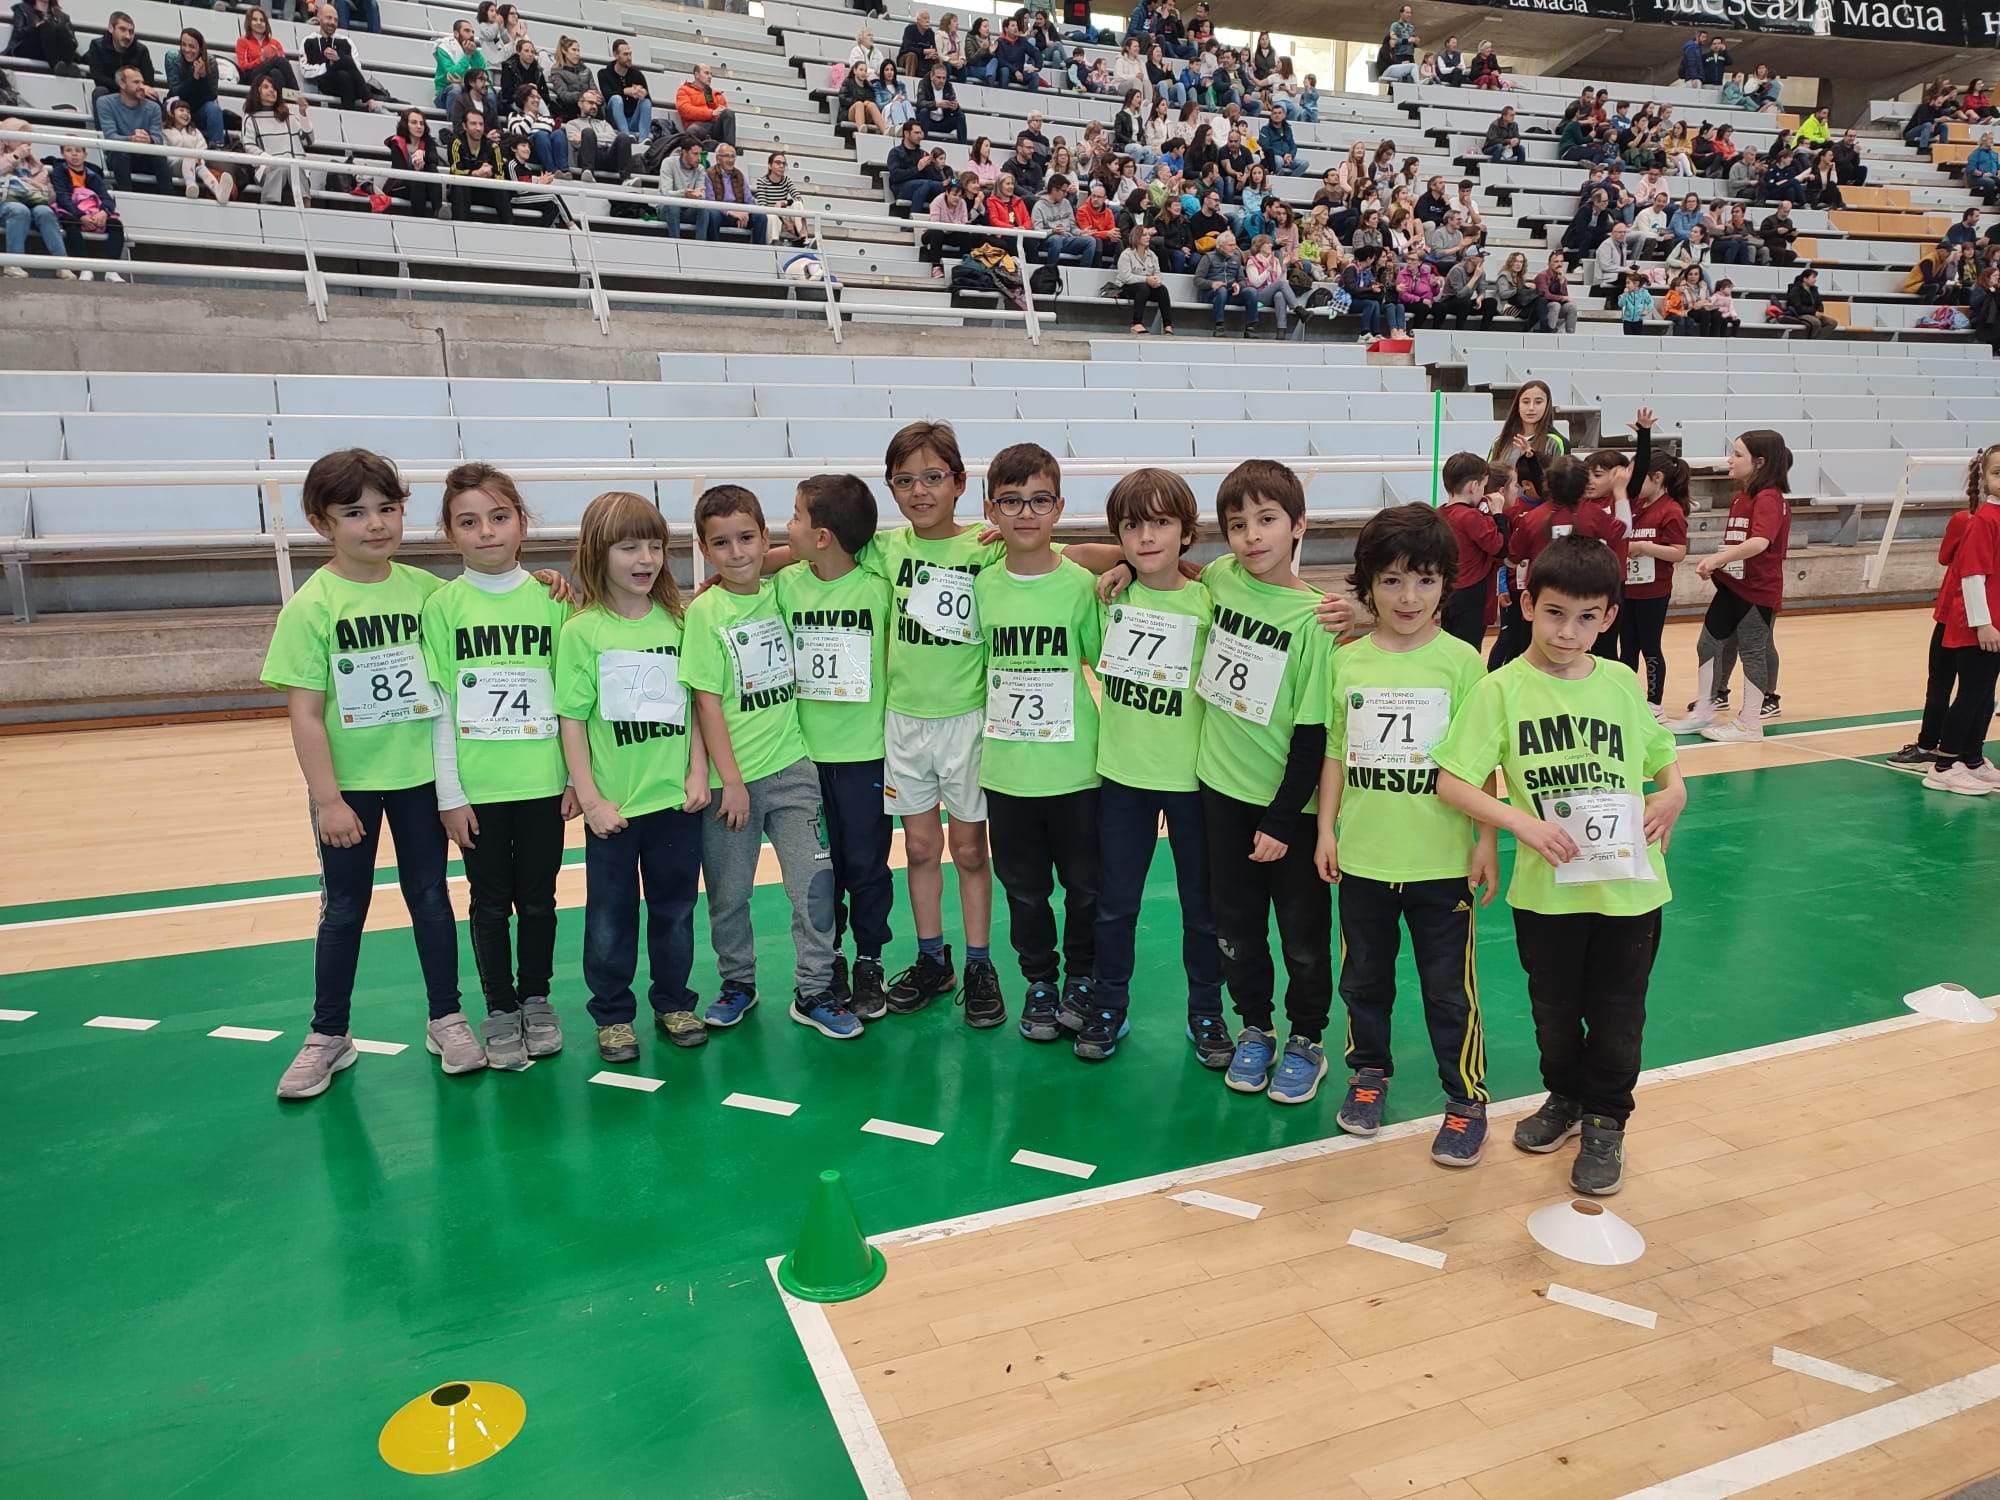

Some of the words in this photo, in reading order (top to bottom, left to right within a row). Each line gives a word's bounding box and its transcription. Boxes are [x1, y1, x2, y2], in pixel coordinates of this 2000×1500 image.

[936, 590, 971, 620] 80
[456, 625, 552, 661] AMYPA
[760, 636, 787, 667] 75
[992, 625, 1068, 657] AMYPA
[1128, 629, 1167, 661] 77
[811, 653, 838, 679] 81
[1214, 653, 1249, 691] 78
[371, 669, 417, 701] 82
[616, 664, 667, 701] 70
[740, 683, 795, 712] HUES
[488, 689, 531, 717] 74
[1008, 693, 1044, 720] 73
[1376, 712, 1415, 744] 71
[1519, 713, 1625, 762] AMYPA
[1348, 766, 1438, 795] HUESCA
[1585, 814, 1620, 841] 67
